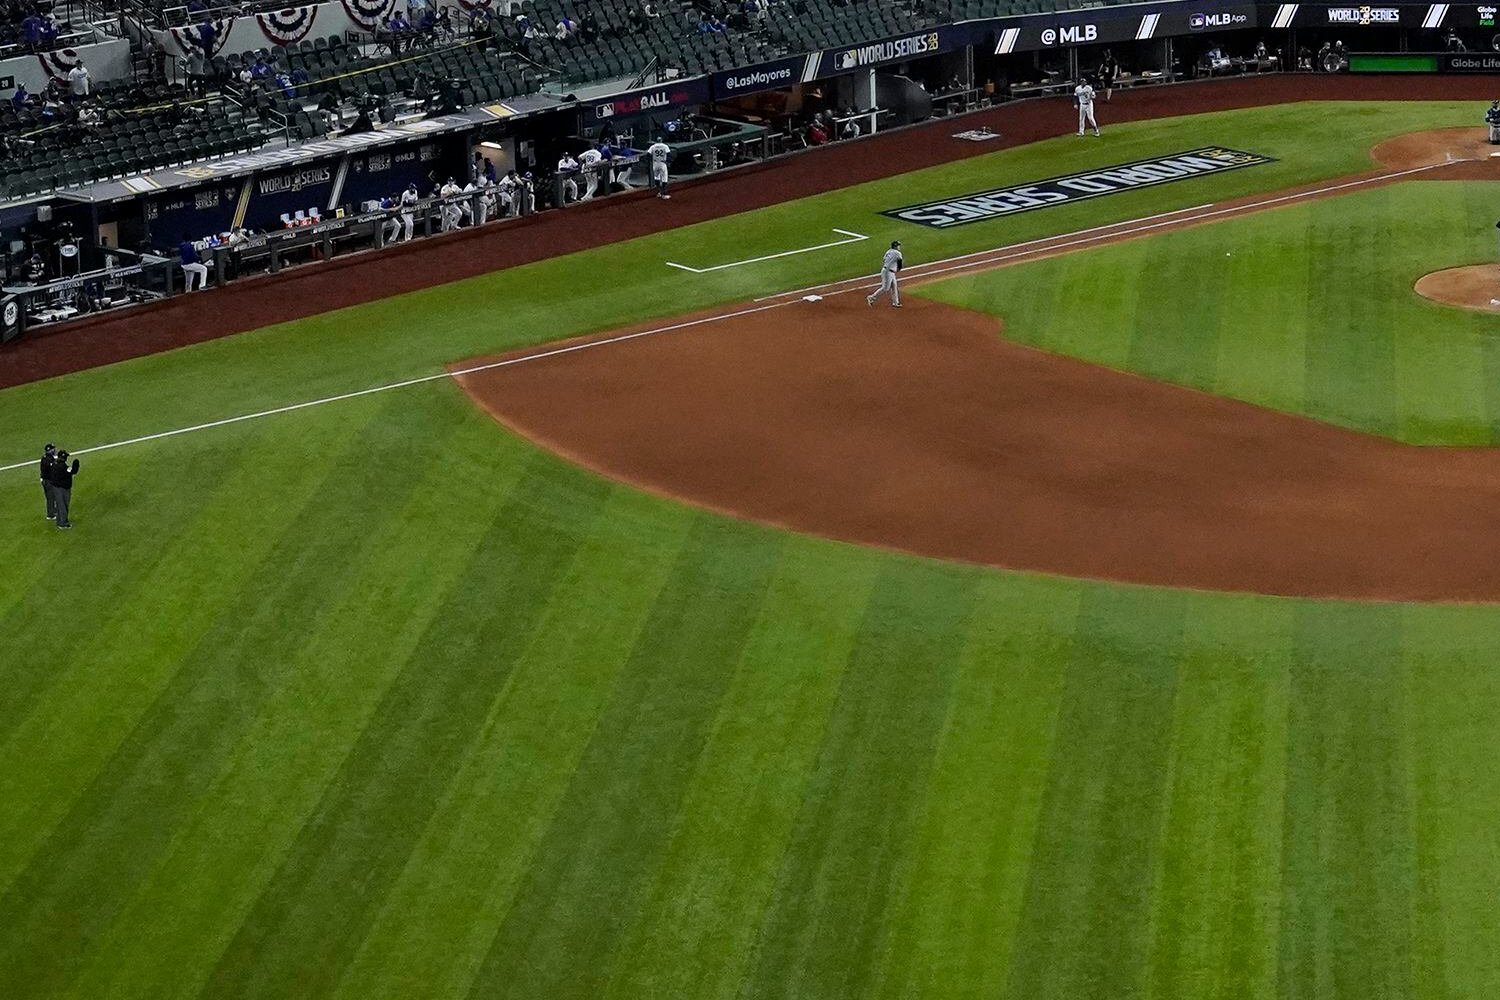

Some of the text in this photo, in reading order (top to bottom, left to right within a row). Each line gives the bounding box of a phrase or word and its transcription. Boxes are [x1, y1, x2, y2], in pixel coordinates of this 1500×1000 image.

[1205, 13, 1247, 26] MLB App
[1328, 9, 1399, 21] WORLD SERIES
[858, 34, 928, 66] WORLD SERIES
[1451, 58, 1480, 68] Globe
[1482, 58, 1500, 68] Life
[726, 67, 791, 89] @LasMayores
[260, 167, 330, 195] WORLD SERIES
[899, 156, 1227, 225] WORLD SERIES
